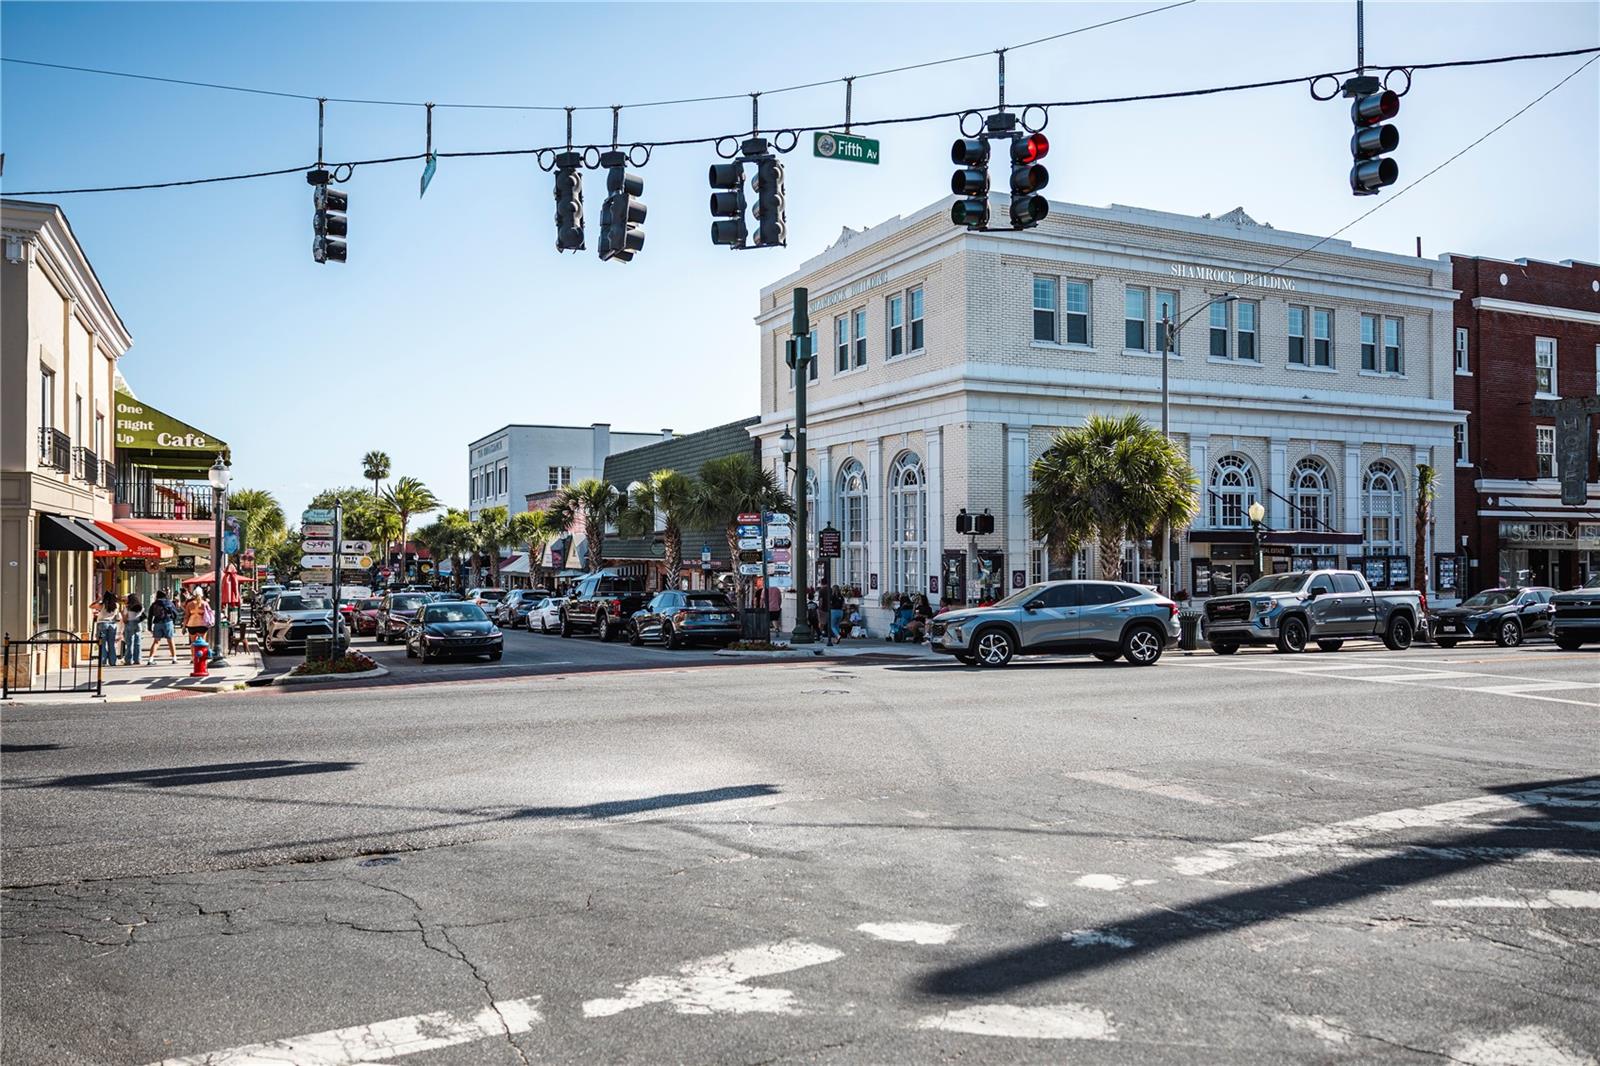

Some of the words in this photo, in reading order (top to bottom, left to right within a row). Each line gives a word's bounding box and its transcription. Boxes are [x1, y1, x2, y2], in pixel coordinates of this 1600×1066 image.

[838, 140, 863, 158] Fifth
[866, 148, 878, 159] Av
[1170, 263, 1236, 283] SHAMROCK
[1243, 272, 1296, 291] BUILDING
[117, 403, 143, 415] One
[117, 419, 154, 432] Flight
[116, 433, 135, 445] Up
